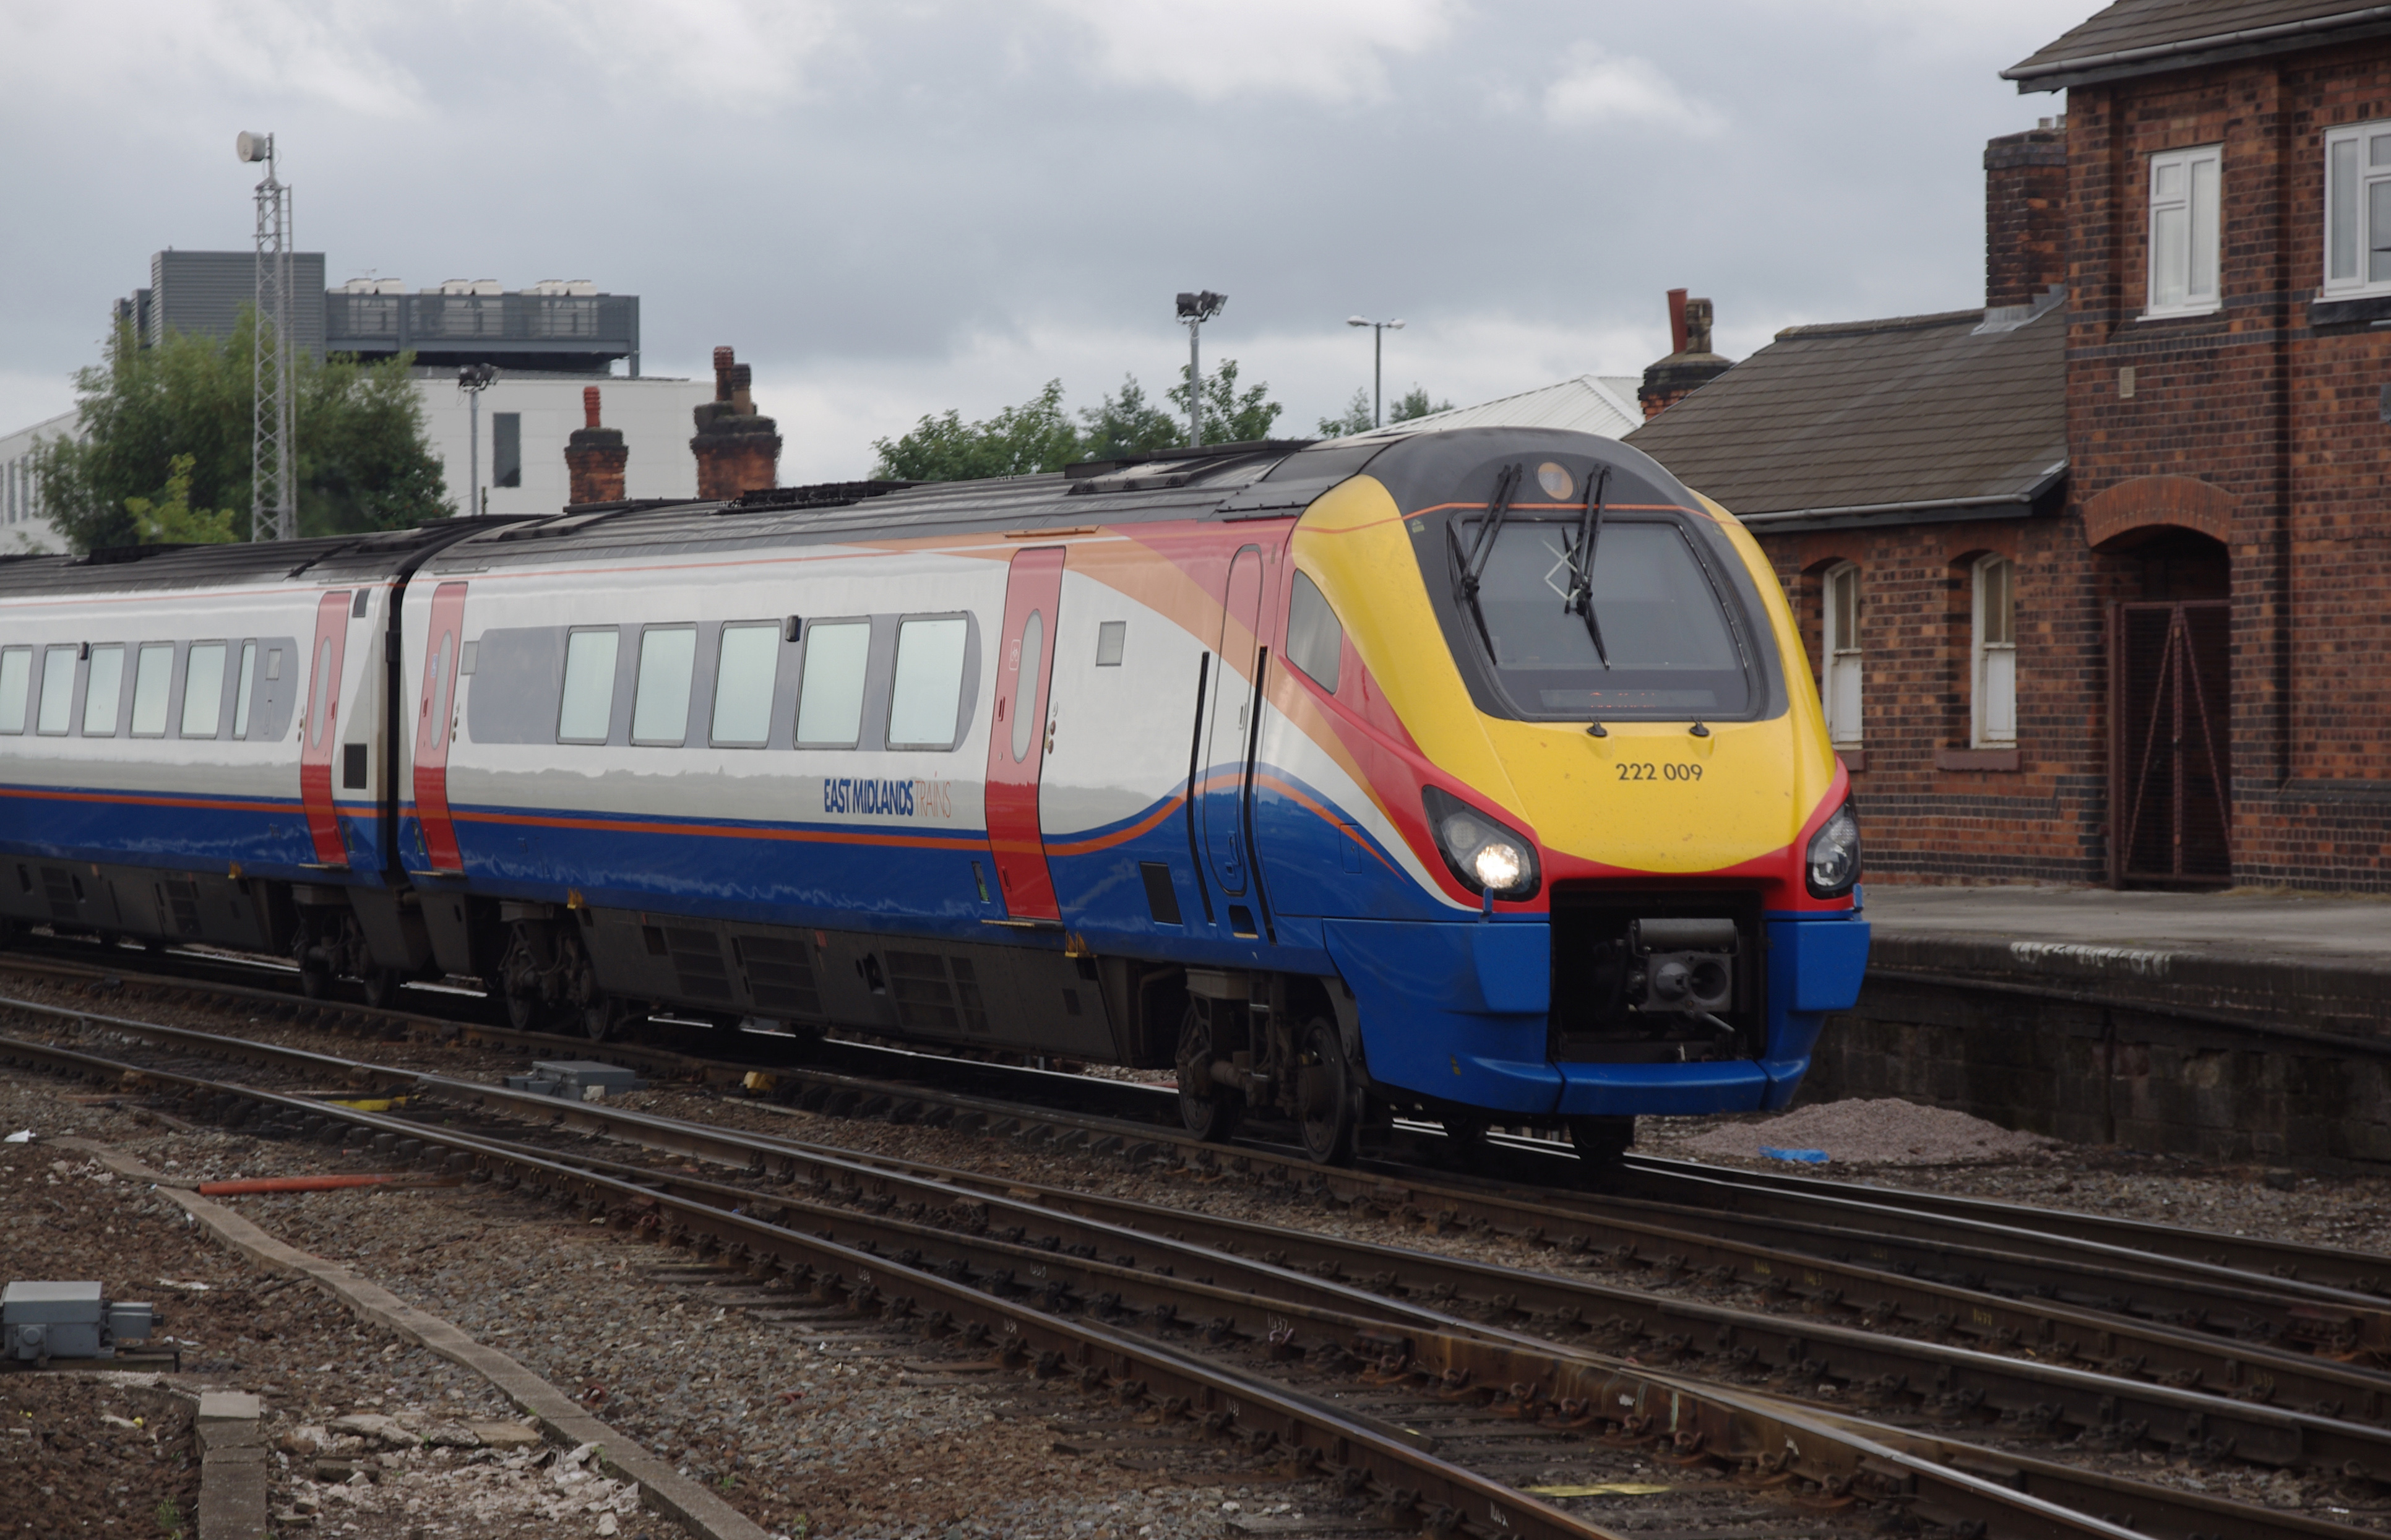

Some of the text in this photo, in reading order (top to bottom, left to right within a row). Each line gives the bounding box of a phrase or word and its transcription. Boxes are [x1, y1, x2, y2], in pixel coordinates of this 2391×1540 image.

[1616, 763, 1703, 781] 222 009
[824, 771, 951, 818] EAST MIDLANDS TRAINS
[1267, 1311, 1288, 1332] 1437
